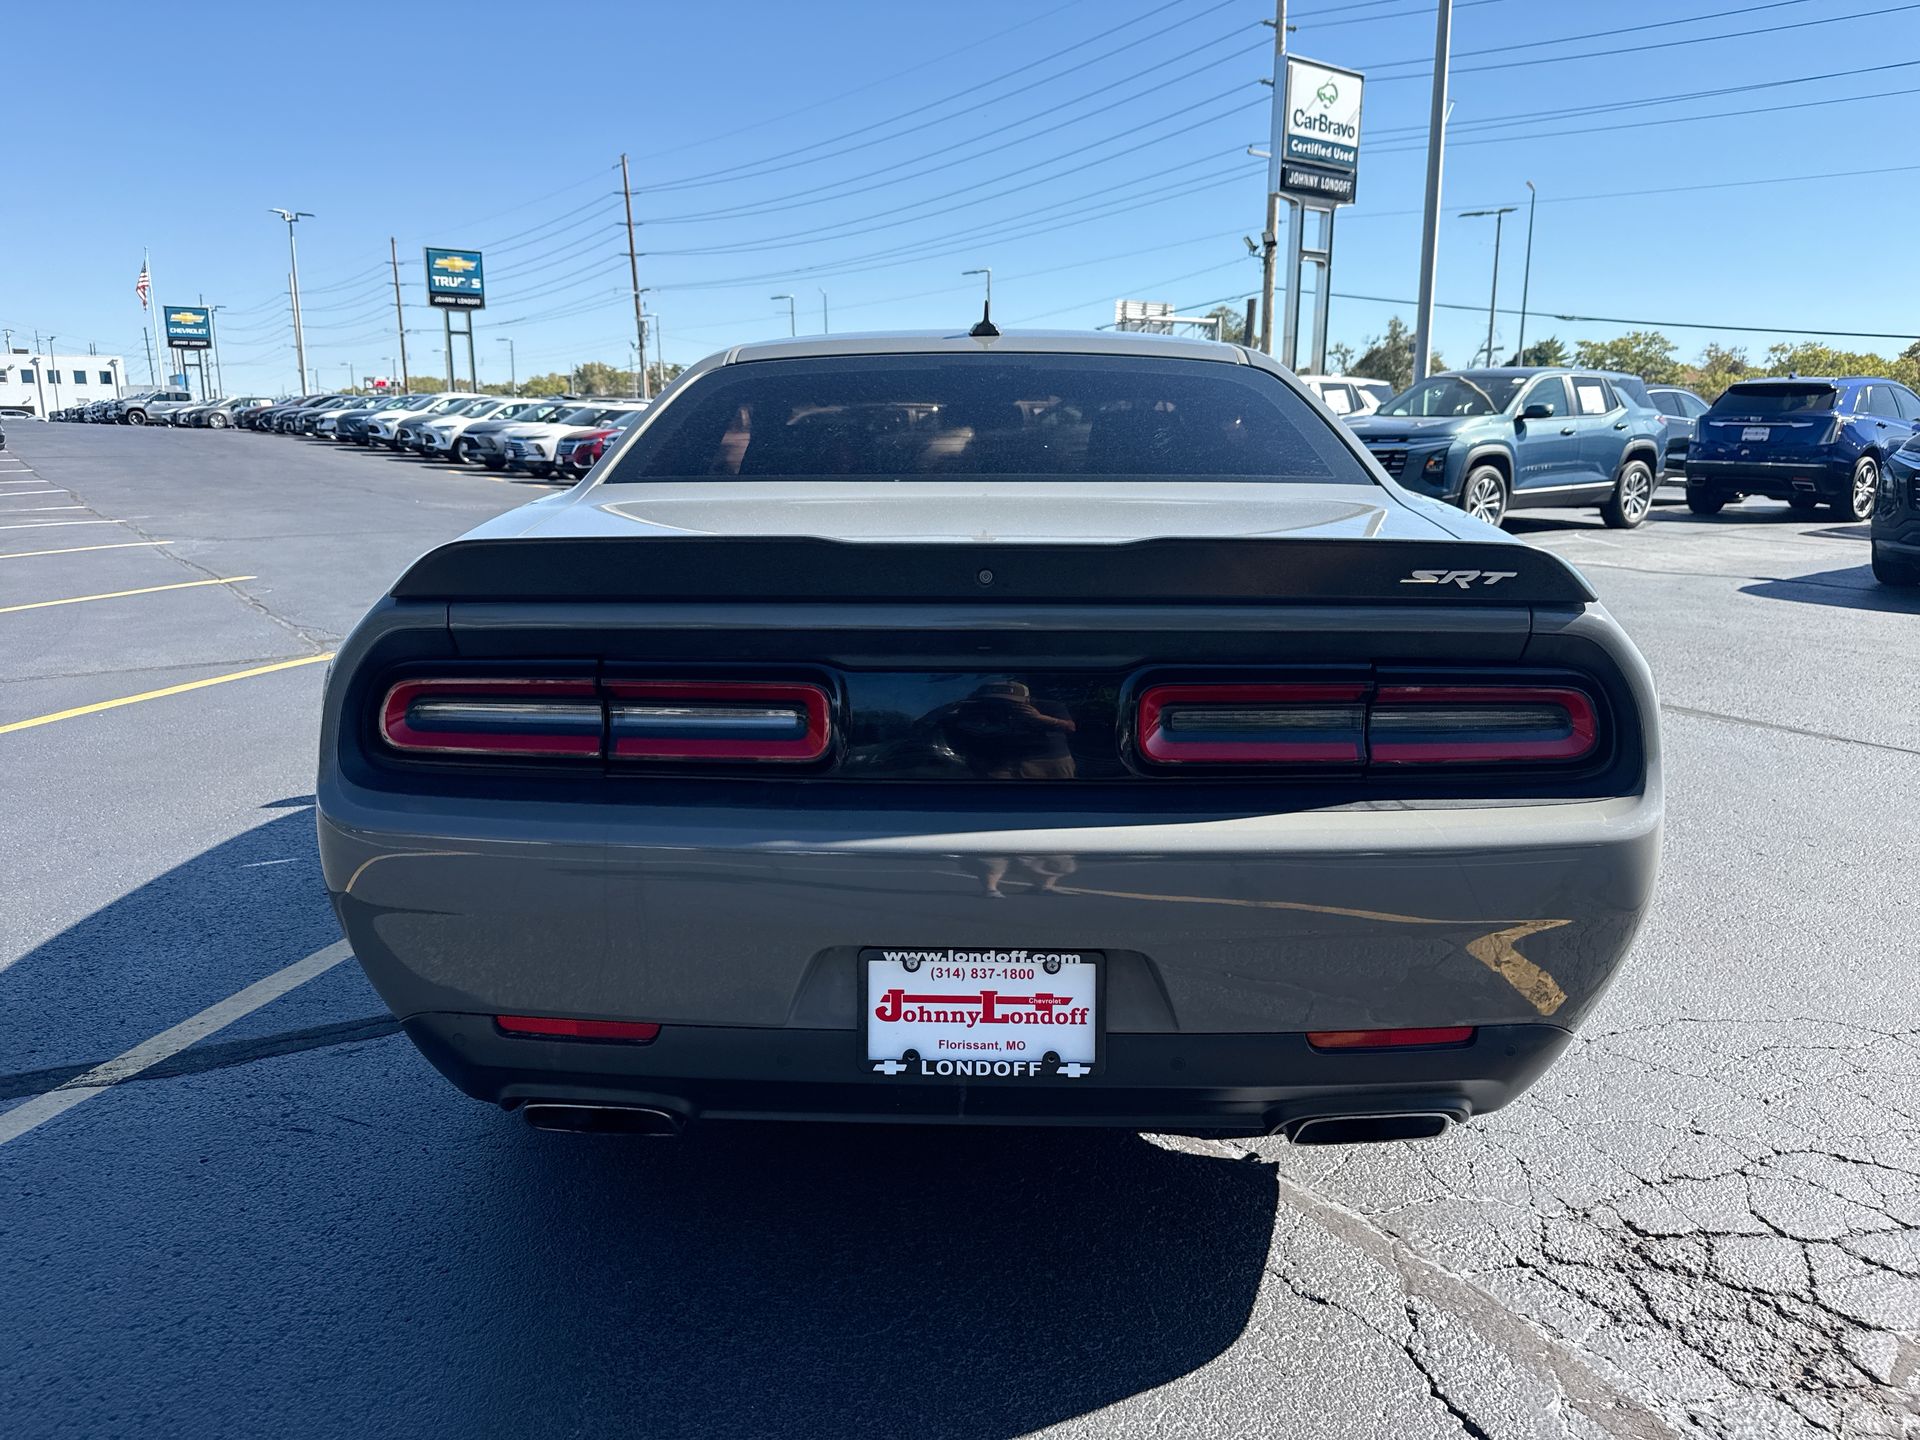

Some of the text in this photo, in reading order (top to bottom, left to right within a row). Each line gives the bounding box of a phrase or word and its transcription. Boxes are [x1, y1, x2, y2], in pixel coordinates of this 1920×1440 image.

[1293, 109, 1355, 139] CarBravo
[1291, 139, 1354, 162] Certified Used
[1288, 172, 1352, 194] JOHNNY LONDOFF
[432, 275, 481, 288] TRUCS
[170, 327, 207, 335] CHEVROLET
[1400, 570, 1518, 589] SRT
[883, 950, 1081, 964] www.londoff.com
[930, 967, 1035, 981] (314) 837-1800
[875, 989, 1090, 1028] Johnny Londoff
[1028, 997, 1062, 1005] Chevrolet
[938, 1039, 1026, 1052] Florissant, MO
[921, 1060, 1042, 1077] LONDOFF
